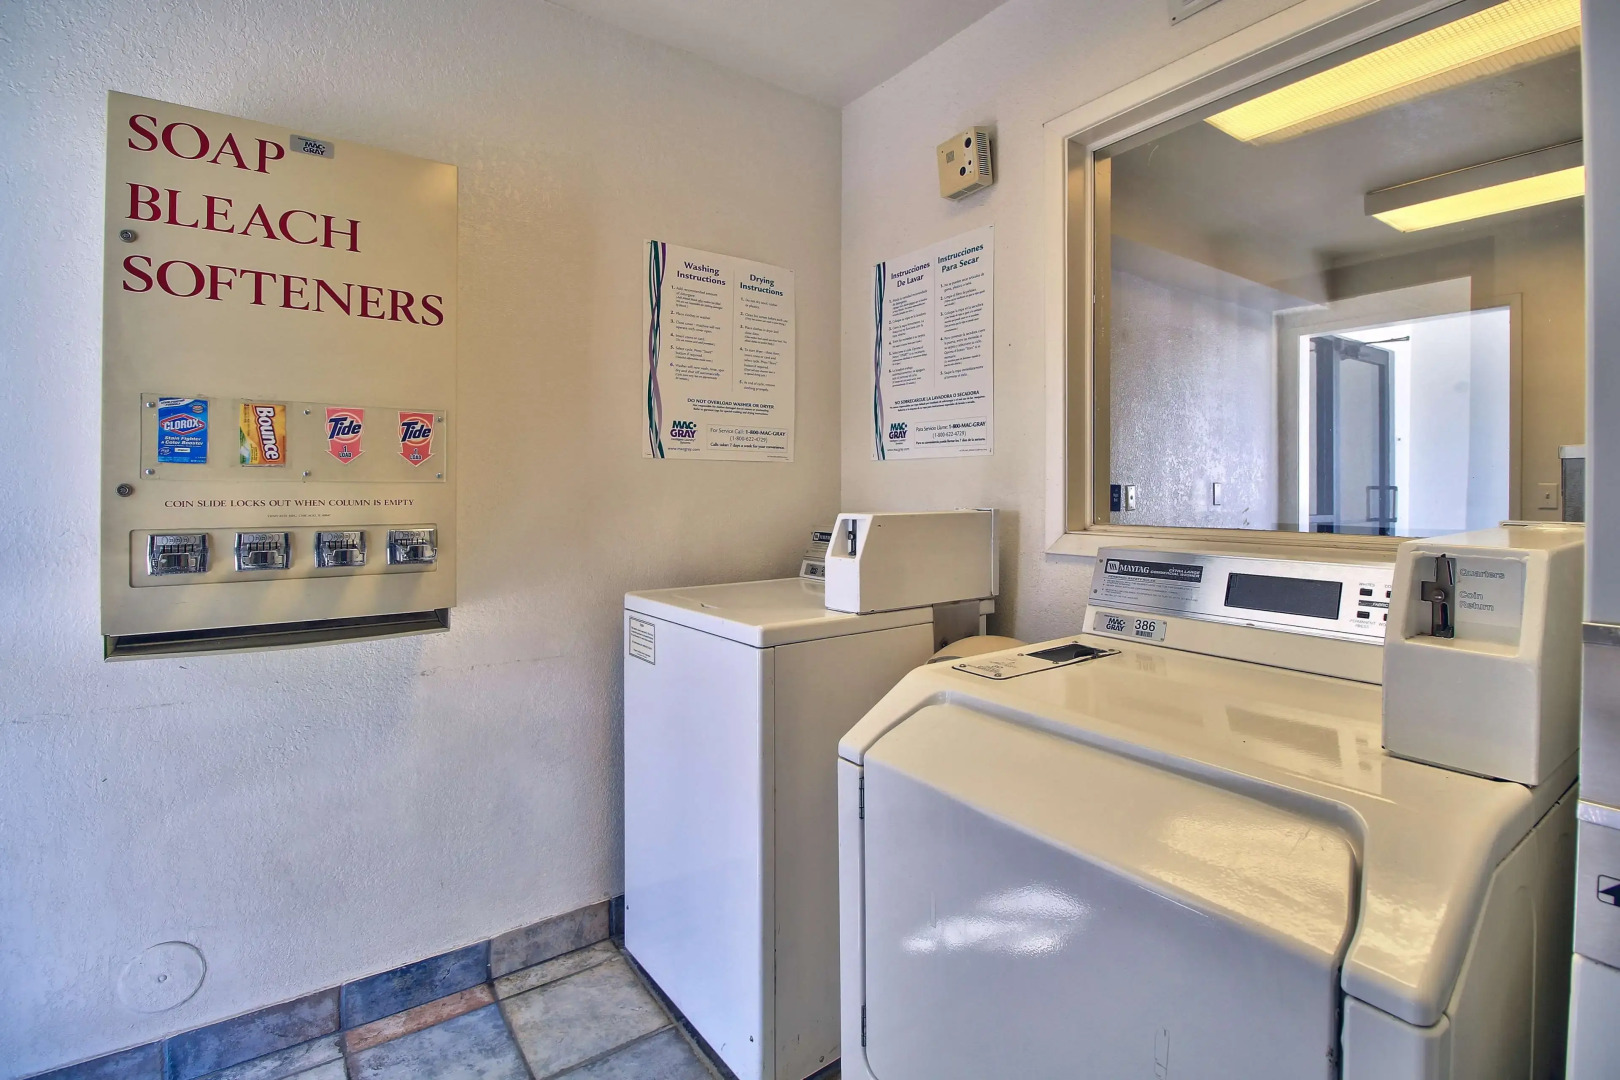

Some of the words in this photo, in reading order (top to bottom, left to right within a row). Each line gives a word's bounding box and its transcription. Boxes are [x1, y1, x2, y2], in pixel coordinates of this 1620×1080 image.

[127, 113, 285, 174] SOAP
[303, 147, 325, 156] GRAY
[125, 182, 361, 253] BLEACH
[938, 244, 984, 264] Instrucciones
[684, 261, 720, 277] Washing
[942, 264, 958, 273] Para
[960, 256, 980, 268] Secar
[891, 262, 930, 280] Instrucciones
[677, 270, 726, 286] Instructions
[750, 274, 775, 287] Drying
[897, 280, 906, 288] De
[907, 274, 924, 285] Lavar
[122, 254, 444, 327] SOFTENERS
[740, 282, 784, 297] Instructions
[957, 390, 980, 398] SECADORA
[164, 419, 199, 430] CLOROX
[328, 417, 362, 440] Tide
[949, 421, 986, 429] 1-800-MAC-GRAY
[256, 406, 280, 460] Bounce
[401, 421, 432, 442] Tide
[670, 429, 697, 439] GRAY
[889, 430, 908, 440] GRAY
[343, 445, 348, 453] 1
[165, 500, 194, 508] COIN
[1120, 564, 1150, 574] MAYTAG
[1459, 568, 1505, 580] Quarters
[1459, 590, 1484, 601] Coin
[1459, 602, 1494, 612] Return
[1106, 624, 1125, 632] GRAY
[1135, 620, 1156, 632] 386
